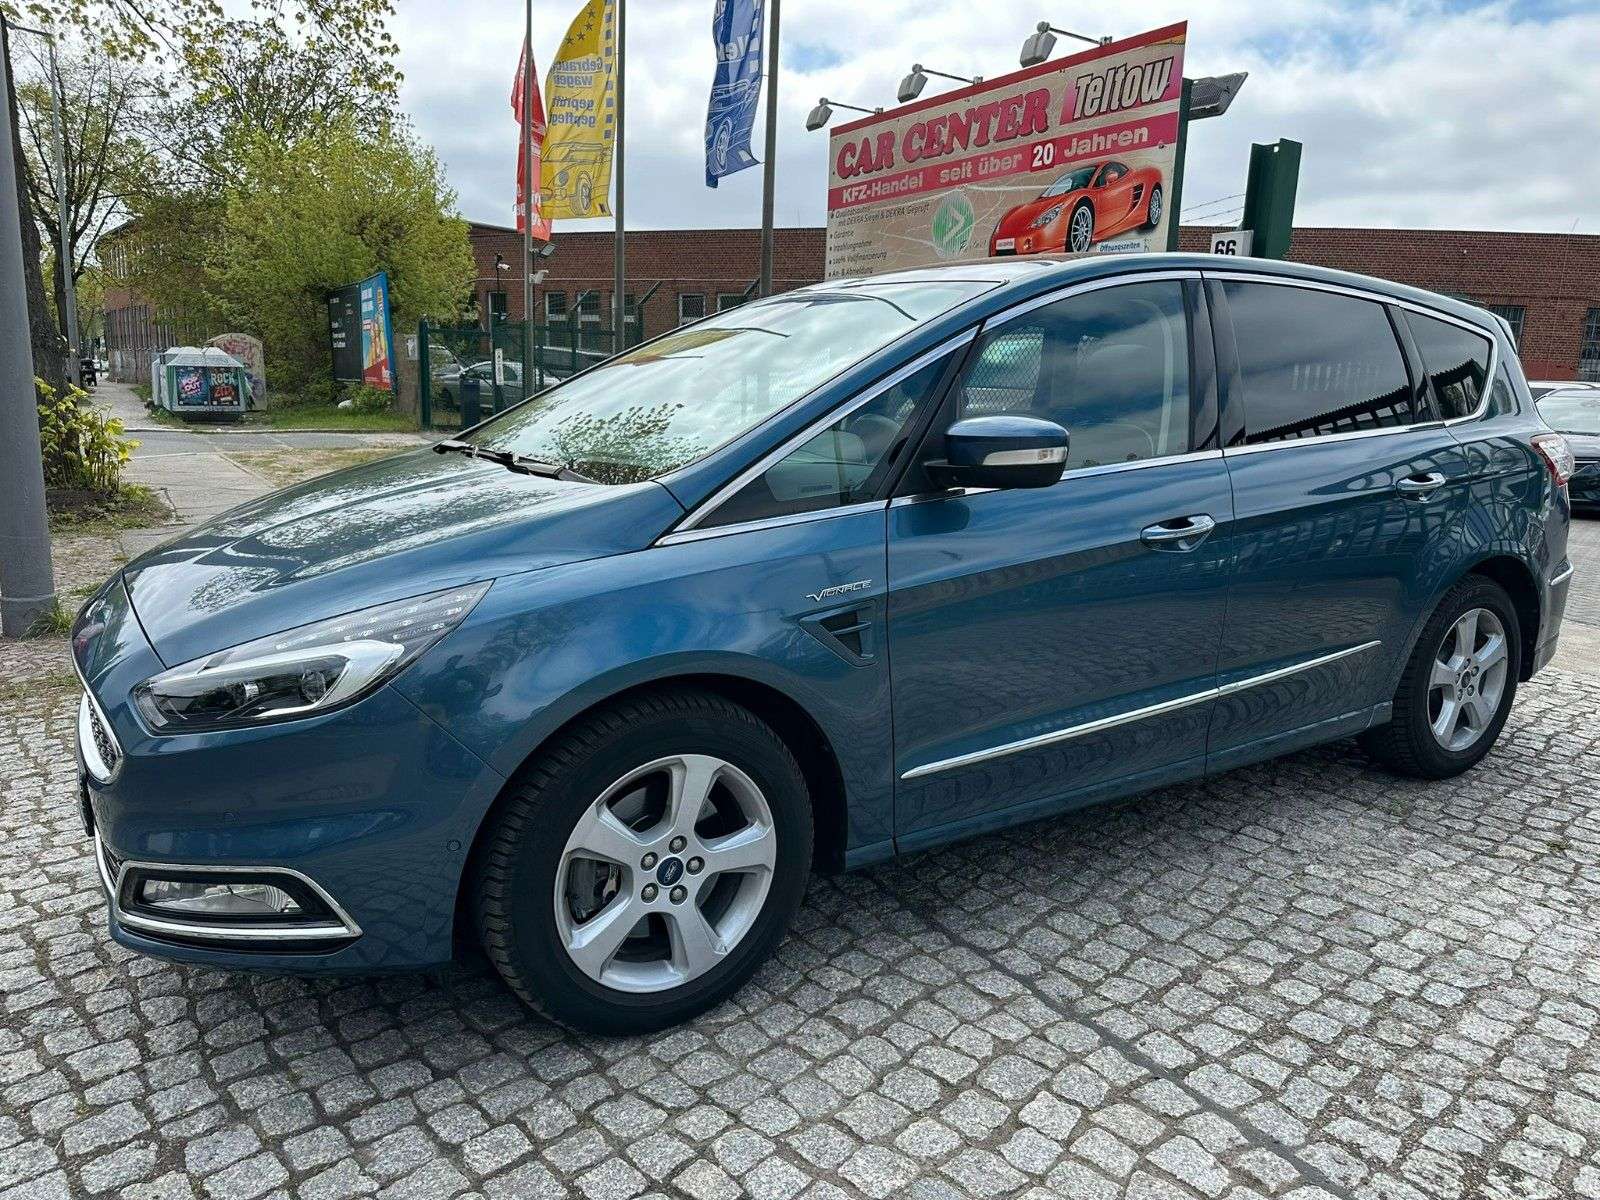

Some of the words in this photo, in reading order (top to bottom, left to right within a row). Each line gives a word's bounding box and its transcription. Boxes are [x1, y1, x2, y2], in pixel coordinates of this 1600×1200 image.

[836, 131, 896, 179] CAR
[902, 88, 1050, 163] CENTER
[1072, 56, 1174, 122] Teltow
[842, 173, 923, 203] KFZ-Handel
[939, 162, 972, 184] seit
[978, 152, 1023, 175] über
[1032, 143, 1054, 168] 20
[1063, 126, 1149, 158] Jahren
[210, 372, 236, 386] ROCK
